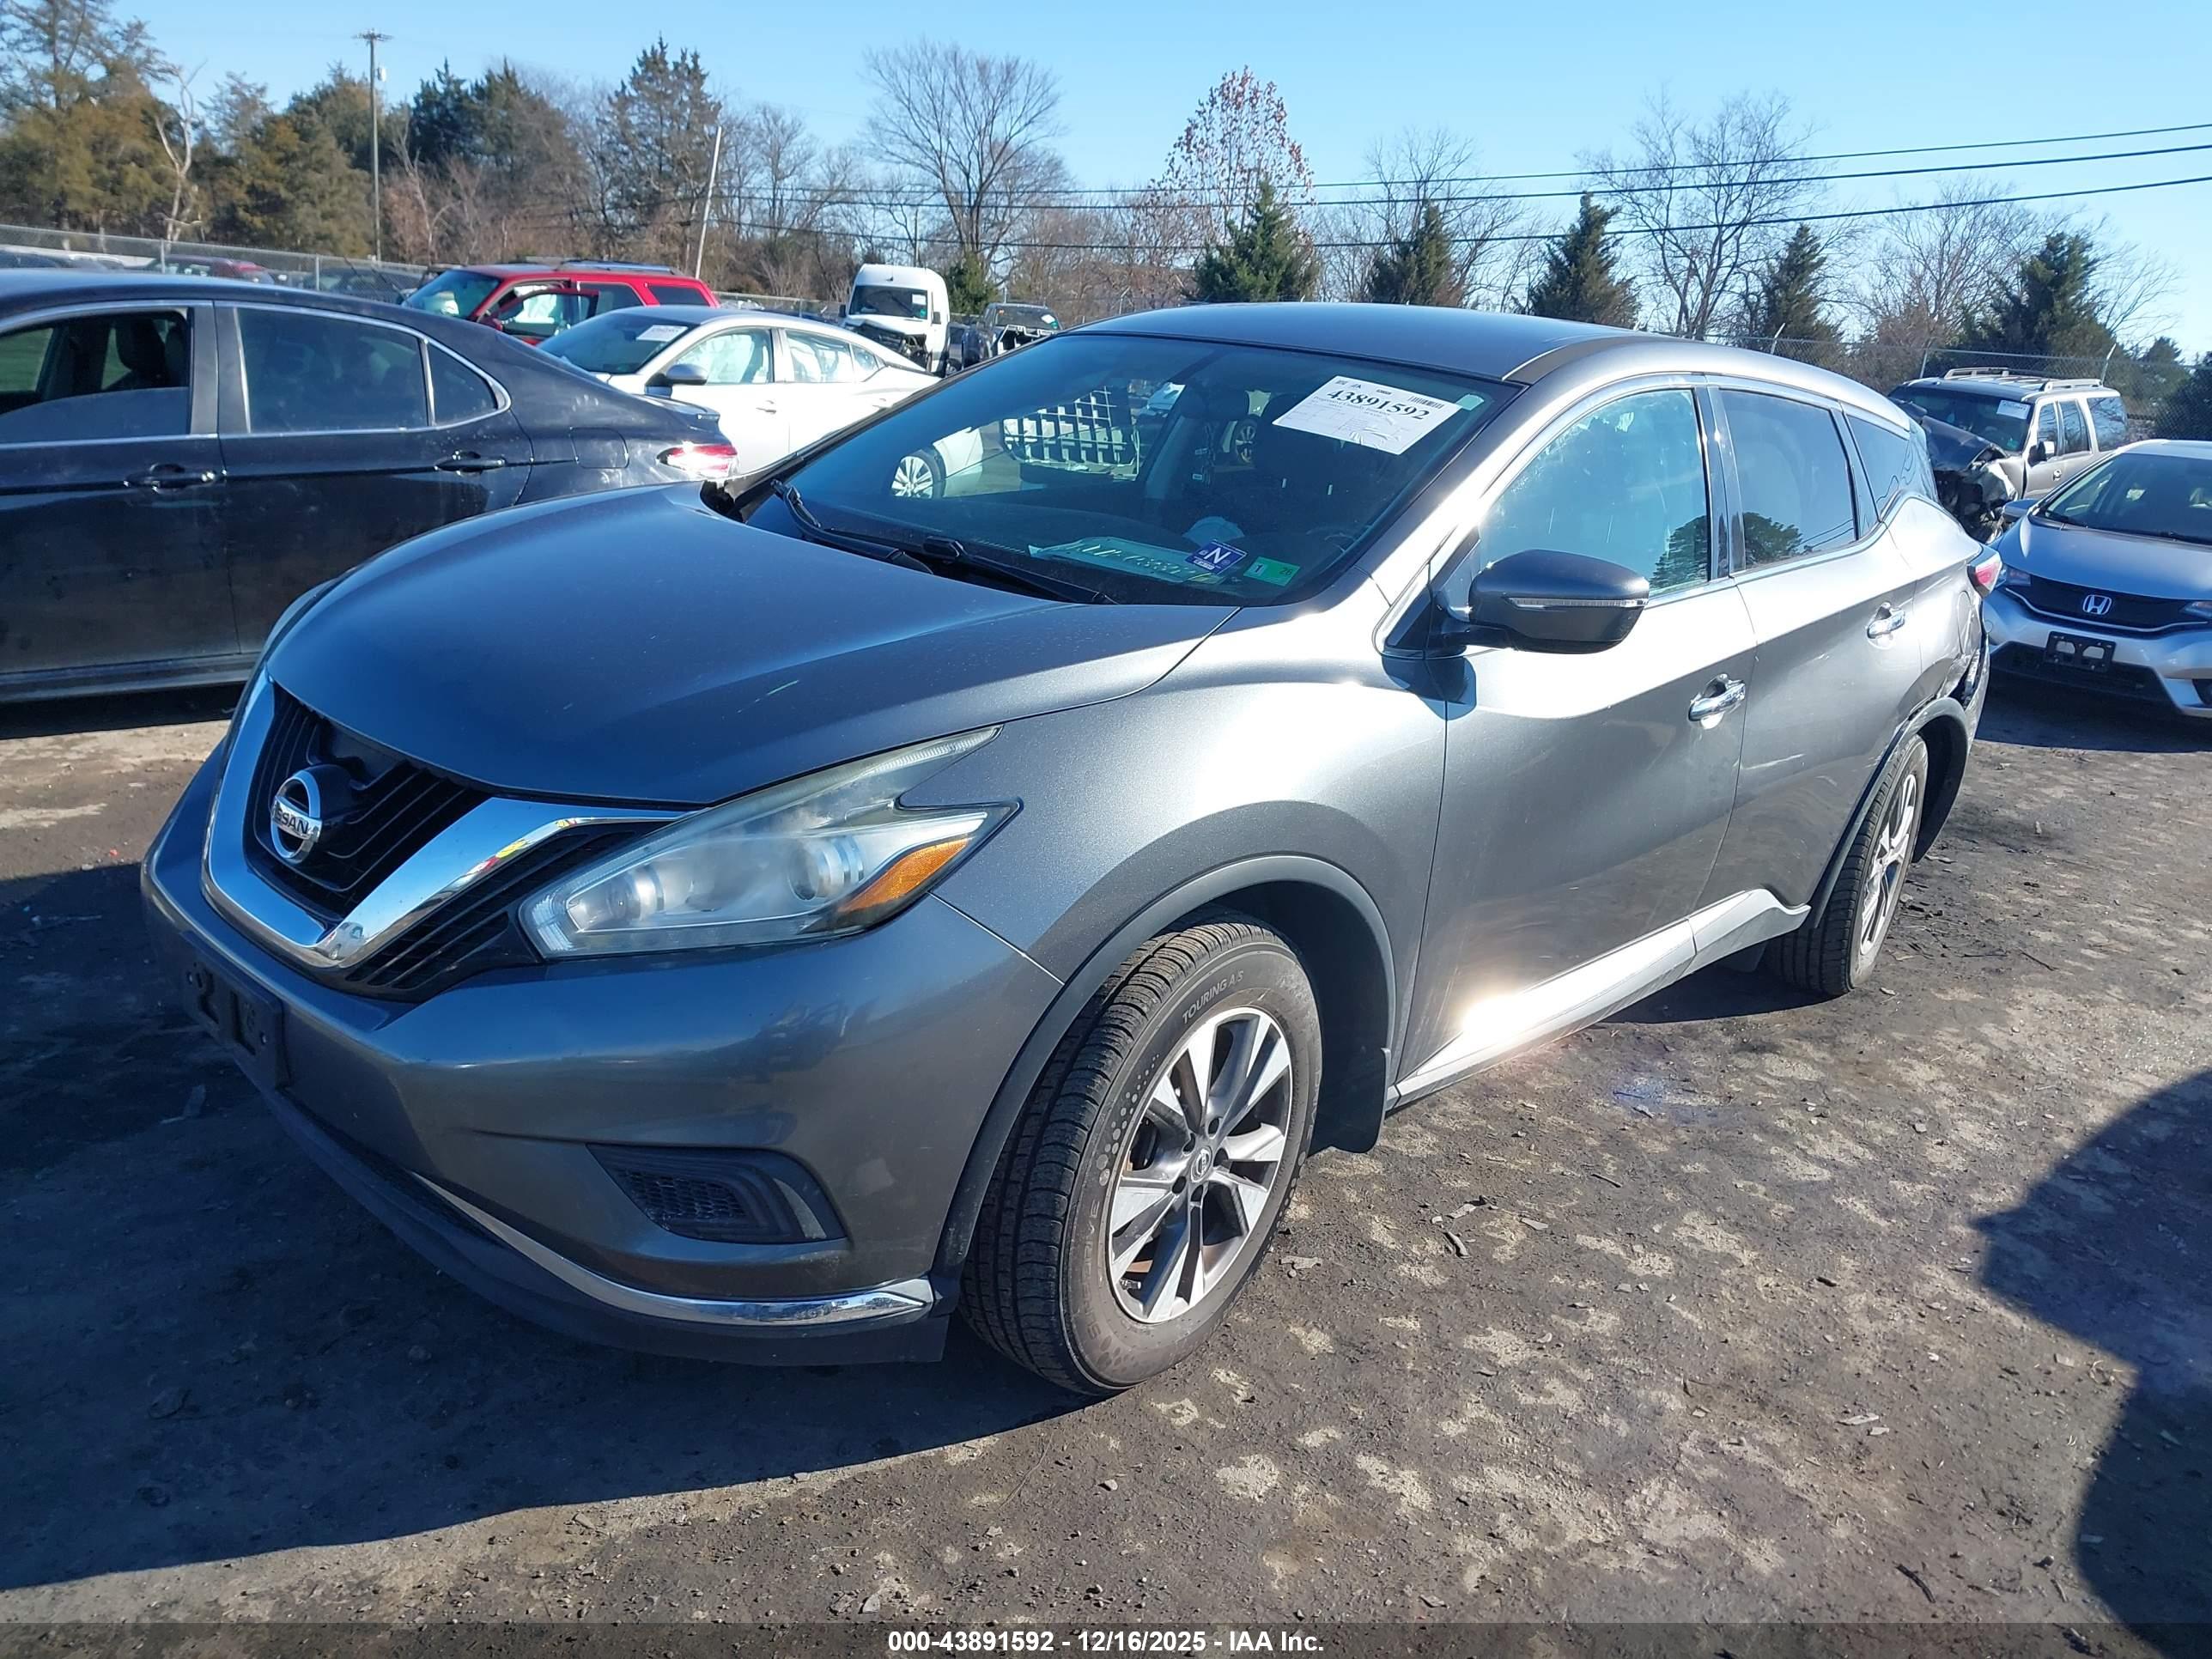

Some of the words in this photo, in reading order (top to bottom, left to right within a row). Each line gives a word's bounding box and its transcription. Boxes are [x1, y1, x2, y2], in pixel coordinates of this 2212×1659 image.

[1327, 389, 1431, 420] 43891592
[1203, 547, 1231, 564] N
[1255, 563, 1263, 573] 1
[1279, 567, 1292, 575] 26
[274, 801, 309, 834] SSAN
[1182, 978, 1227, 1024] TOURING
